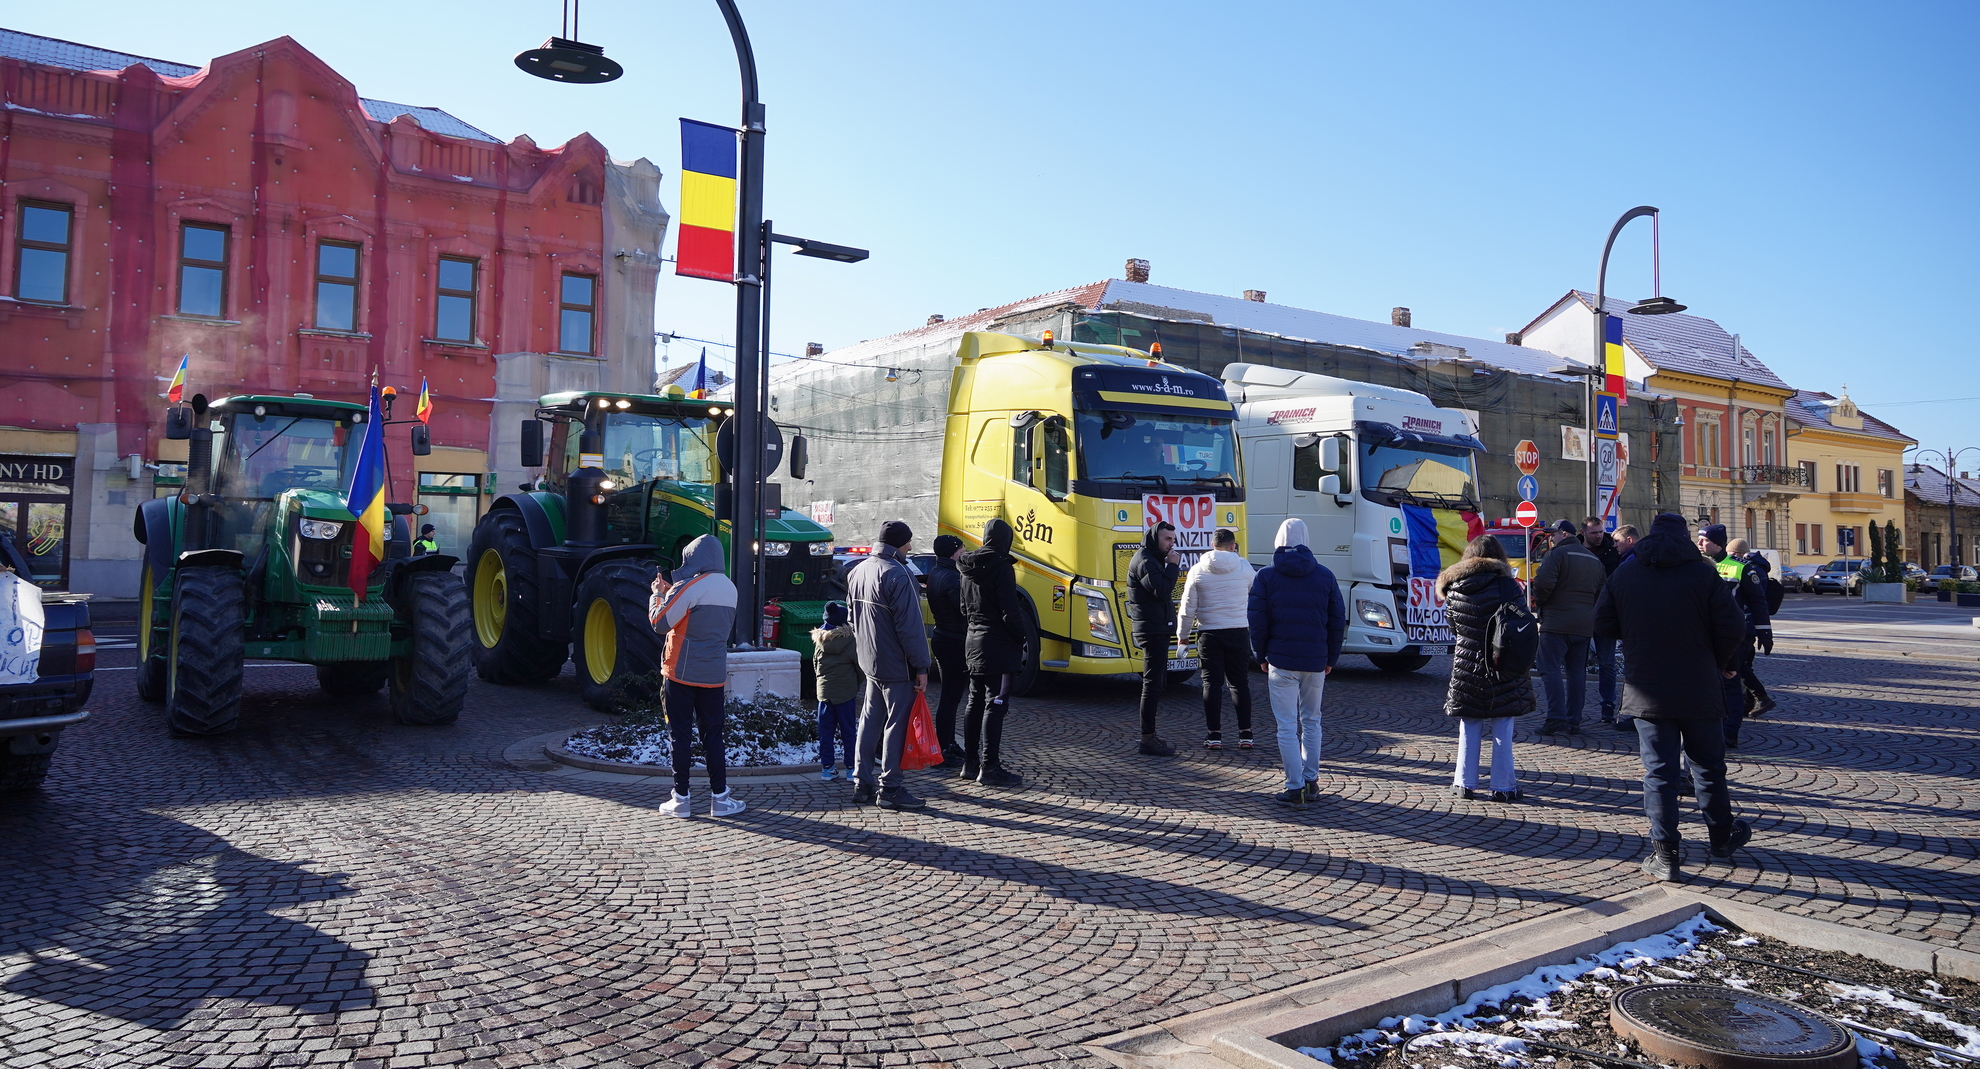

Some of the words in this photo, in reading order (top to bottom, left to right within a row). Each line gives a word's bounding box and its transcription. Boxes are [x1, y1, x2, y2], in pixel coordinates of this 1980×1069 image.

[1517, 450, 1538, 464] STOP
[1603, 449, 1612, 464] 20
[33, 464, 63, 480] HD
[1146, 495, 1213, 529] STOP
[1410, 578, 1446, 608] STO
[1409, 608, 1448, 624] IMPOR
[1177, 660, 1185, 669] 70
[1186, 659, 1198, 668] AGR
